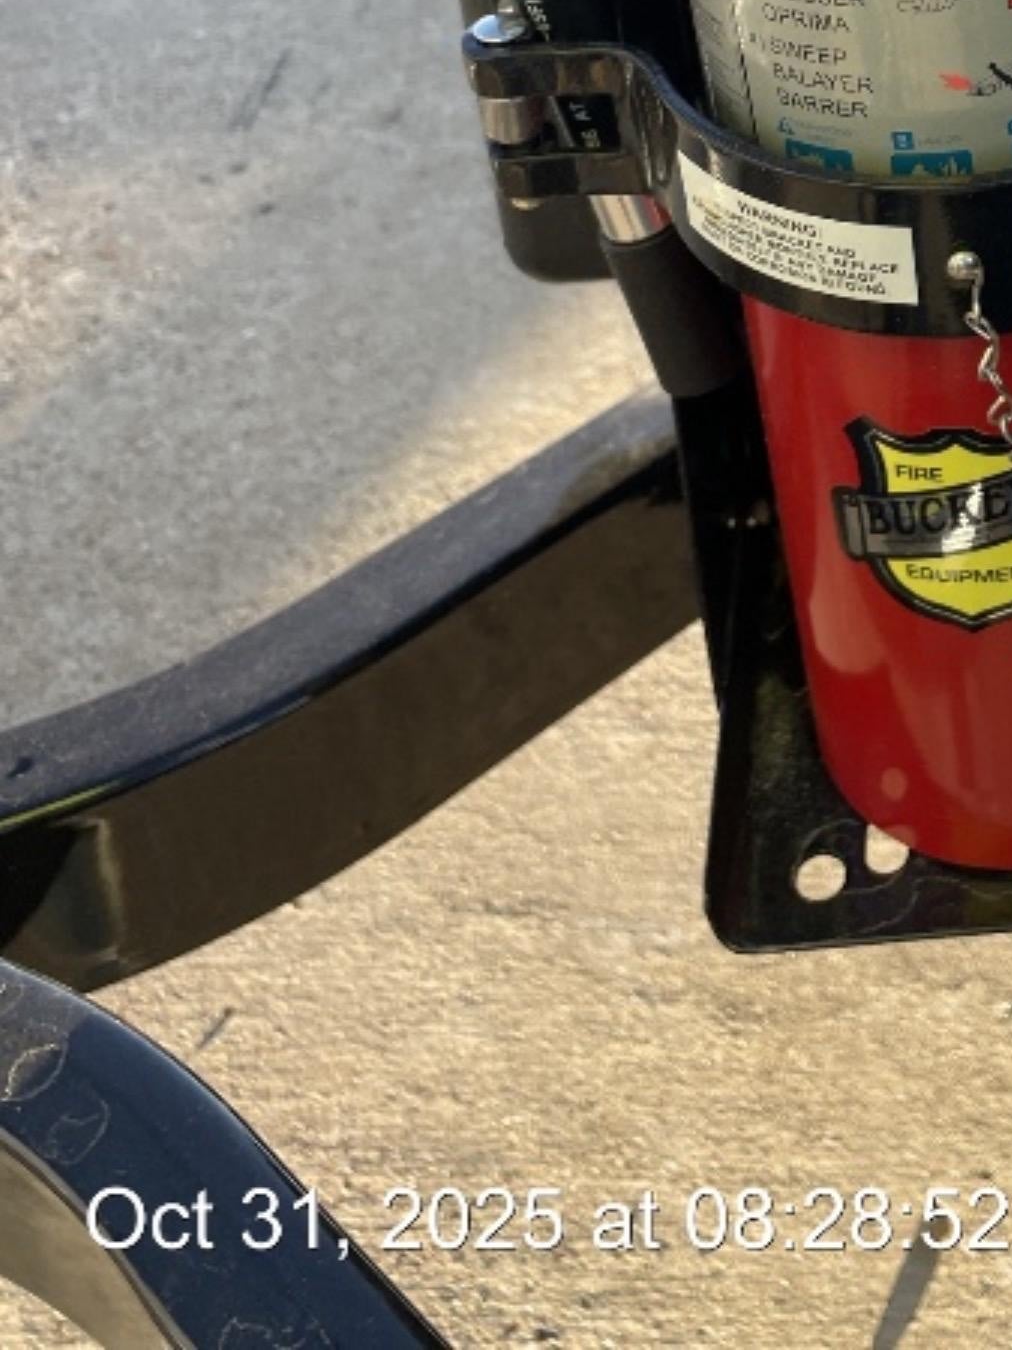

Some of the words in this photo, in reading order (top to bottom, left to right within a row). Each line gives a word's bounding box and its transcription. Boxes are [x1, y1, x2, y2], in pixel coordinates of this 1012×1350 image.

[761, 1, 852, 33] OPRIMA
[769, 35, 848, 65] SWEEP
[772, 61, 875, 94] BALAYER
[776, 86, 869, 118] BARRER
[894, 464, 945, 483] FIRE
